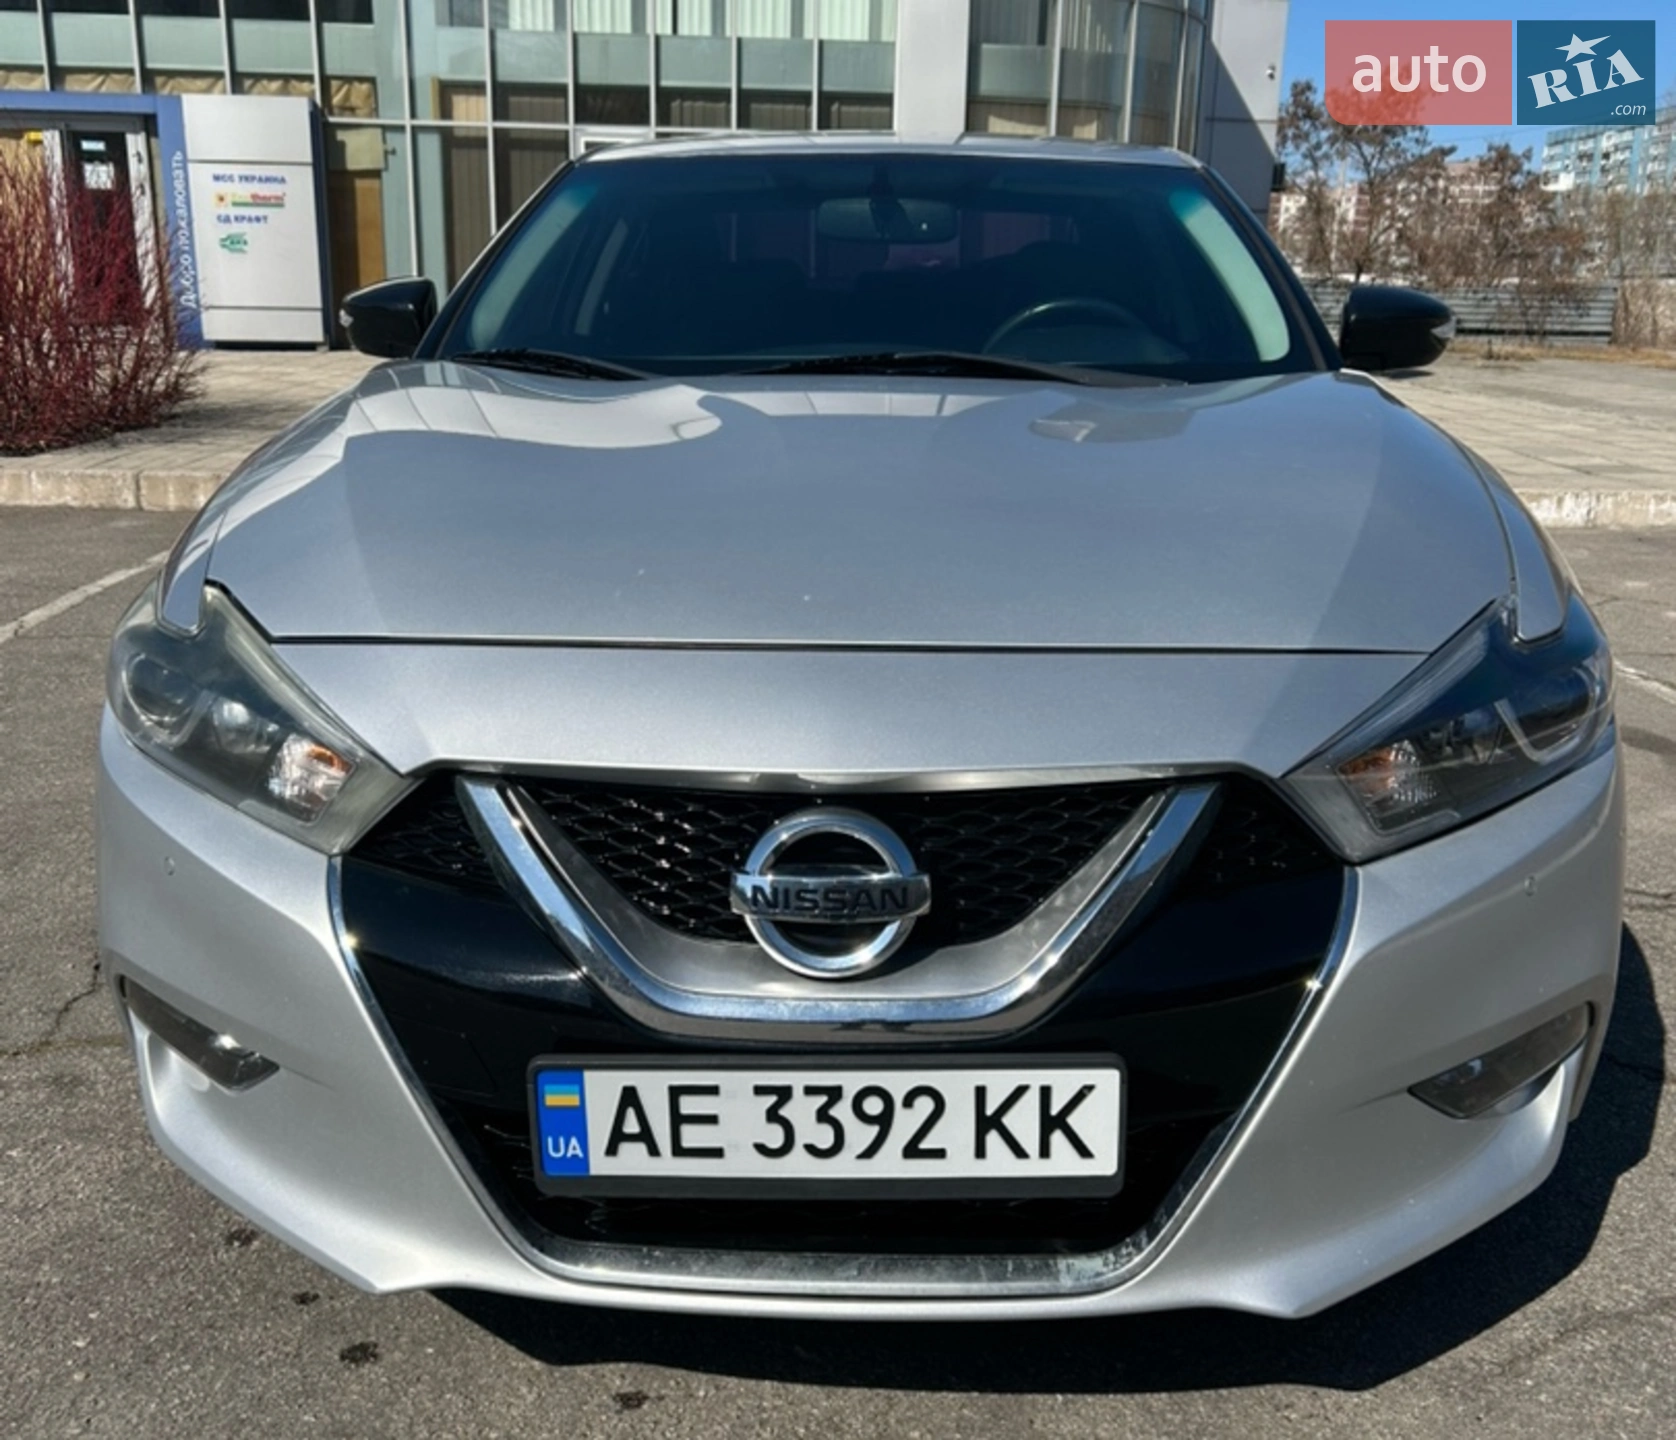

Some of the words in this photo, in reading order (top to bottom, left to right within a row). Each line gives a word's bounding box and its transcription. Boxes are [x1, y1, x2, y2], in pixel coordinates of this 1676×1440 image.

[171, 150, 190, 251] пожаловать
[751, 885, 909, 913] NISSAN
[604, 1085, 725, 1158] AE
[752, 1085, 947, 1159] 3392
[973, 1084, 1096, 1159] KK
[547, 1136, 584, 1159] UA
